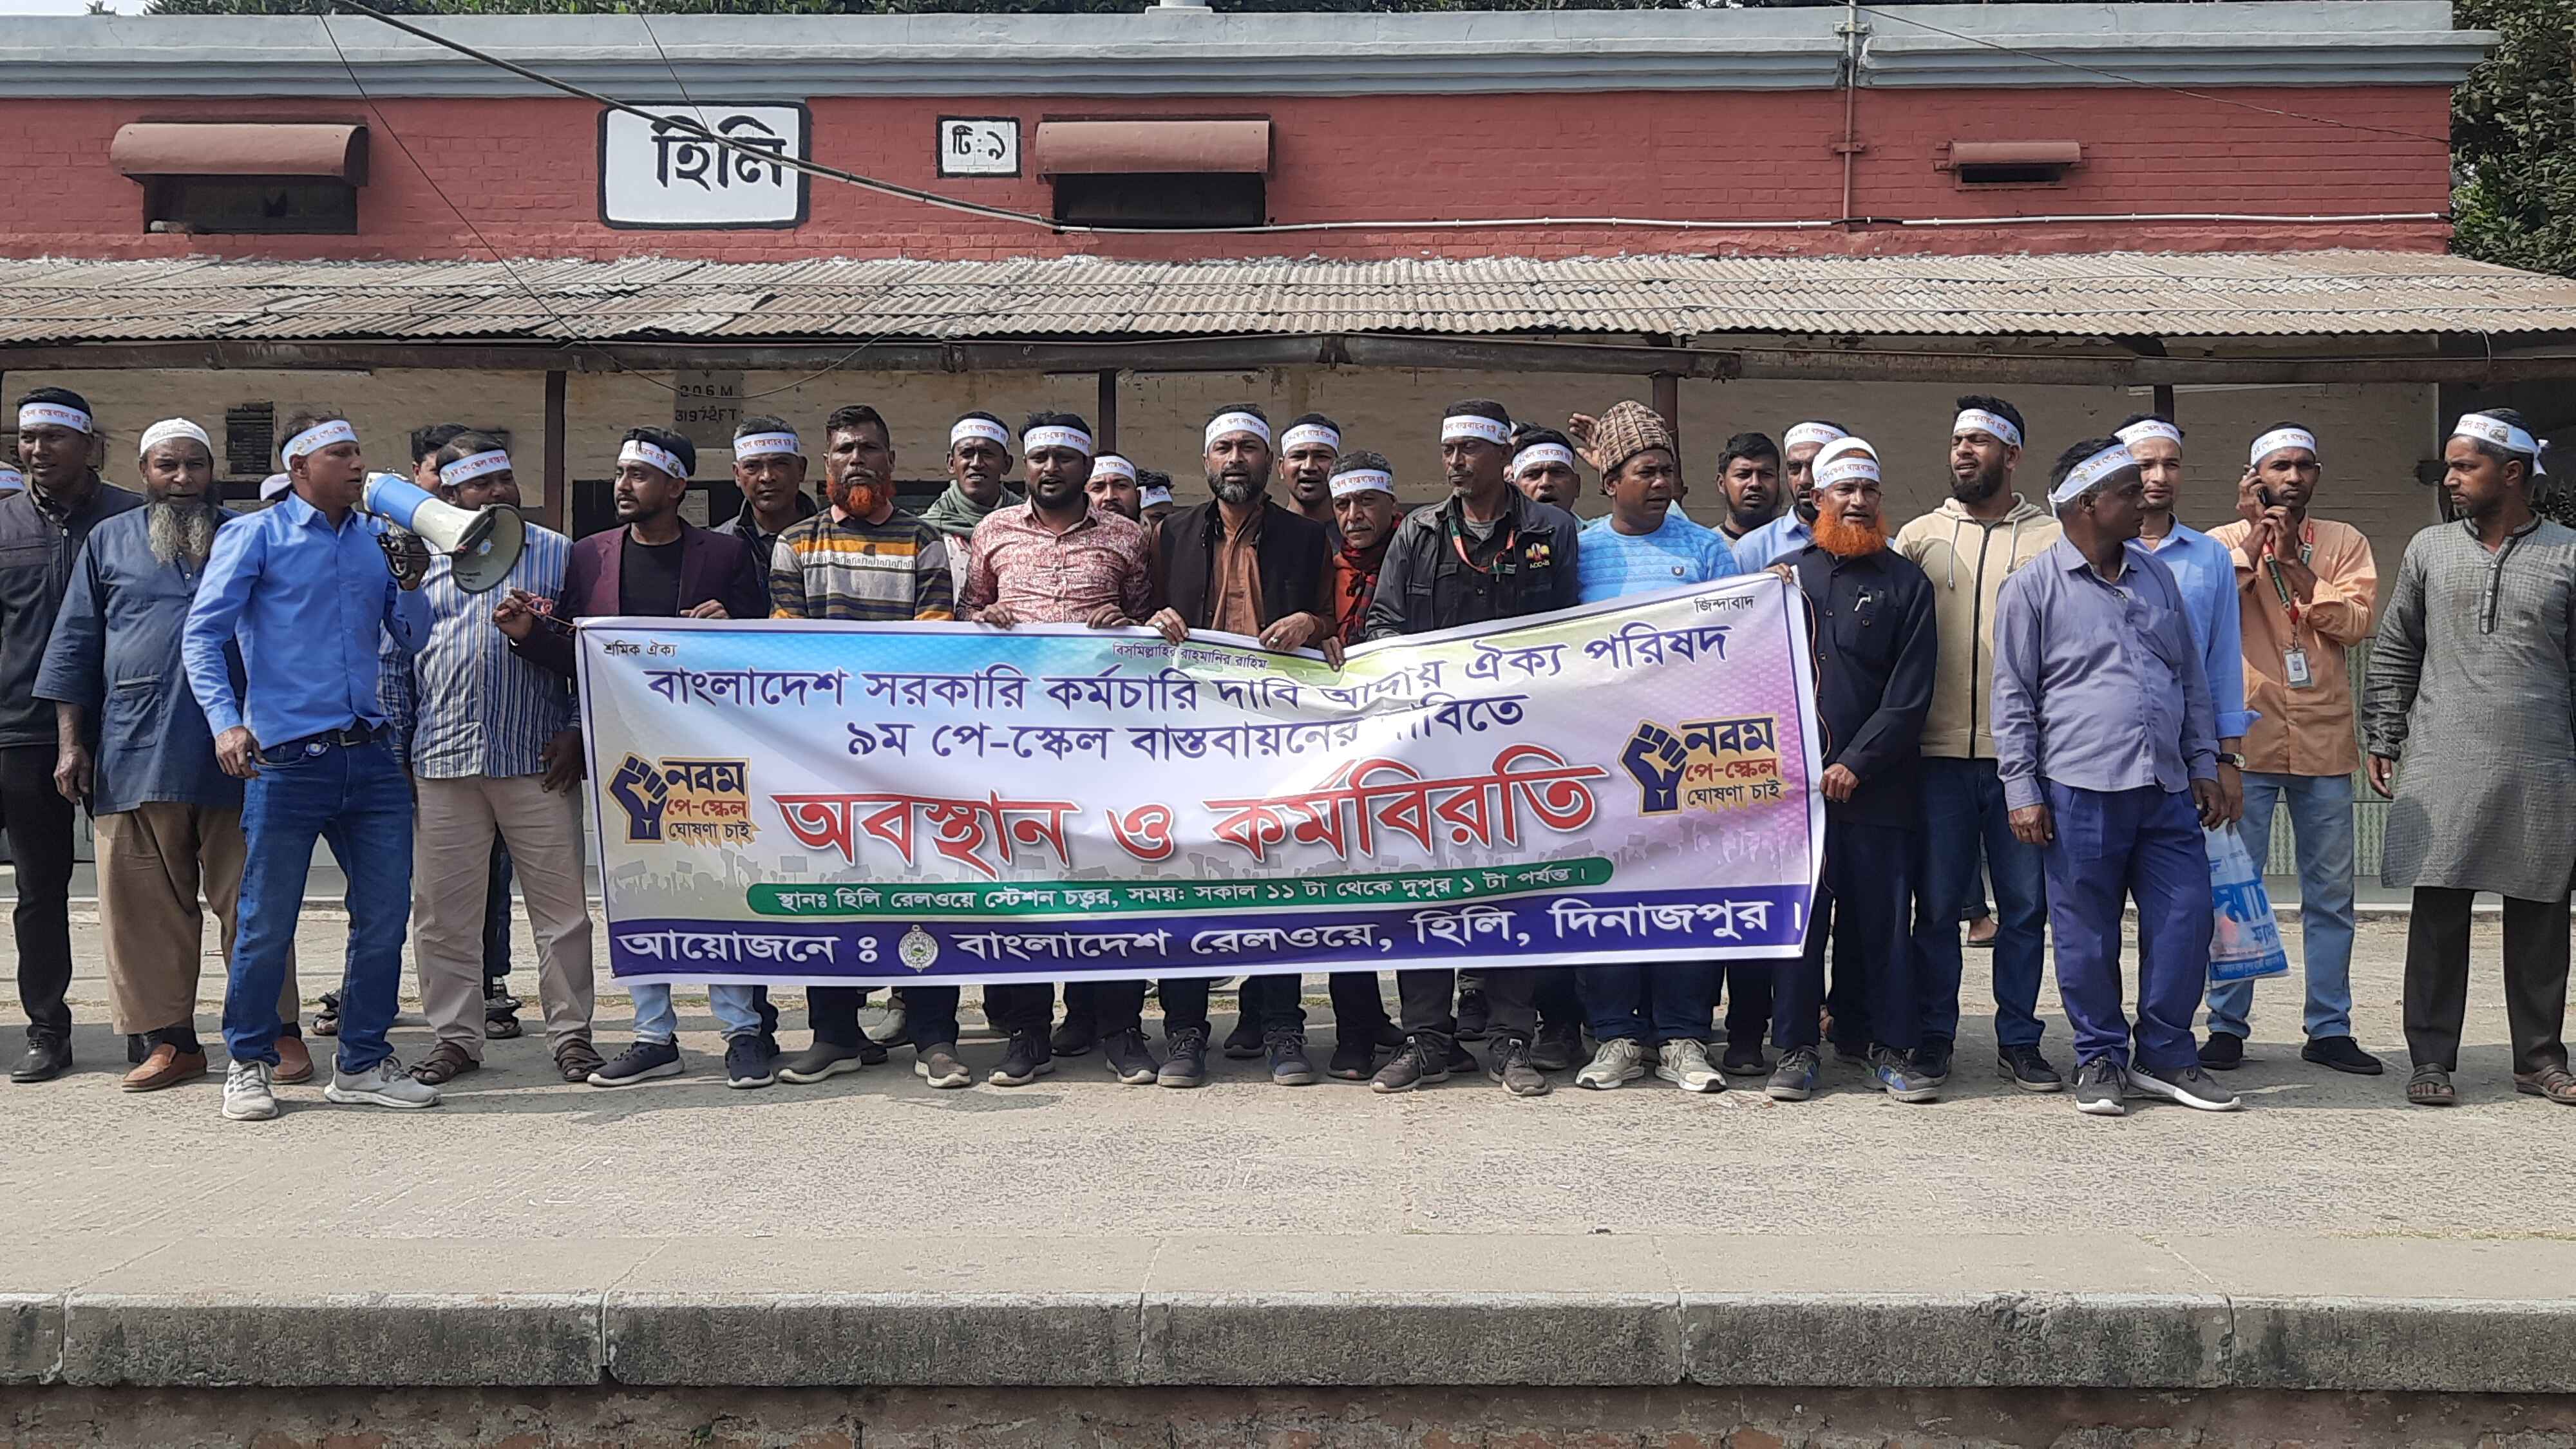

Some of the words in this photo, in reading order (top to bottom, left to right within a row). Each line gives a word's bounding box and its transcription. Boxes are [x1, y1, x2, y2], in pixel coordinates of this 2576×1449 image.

[651, 115, 786, 192] হিলি
[1694, 594, 1756, 614] জিন্দাবাদ
[603, 639, 641, 657] শ্রমিক
[647, 639, 677, 657] ঐক্য
[1235, 653, 1268, 670] রাহিম
[643, 667, 849, 708] বাংলাদেশ
[864, 661, 1030, 710] সরকারি
[1041, 661, 1202, 712] কর্মচারি
[1212, 672, 1306, 711] দাবি
[1320, 659, 1448, 708] আদায়
[1465, 641, 1568, 681] ঐক্য
[1584, 621, 1733, 669] পরিষদ
[846, 721, 916, 758] ৯ম
[932, 721, 1114, 762] পে-স্কেল
[1126, 716, 1360, 761] বাস্তবায়নের
[1681, 717, 1776, 758] নবম
[662, 761, 746, 795] নবম
[1685, 757, 1777, 782] পে-স্কেল
[1688, 784, 1745, 805] ঘোষণা
[1749, 778, 1782, 799] চাই
[667, 799, 747, 819] পে-স্কেল
[772, 790, 1080, 878] অবস্থান
[1105, 802, 1175, 862] ও
[1204, 745, 1606, 862] কর্মবিরতি
[669, 820, 719, 838] ঘোষণা
[723, 819, 752, 839] চাই
[835, 887, 882, 909] হিলি
[890, 891, 977, 909] রেলওয়ে
[985, 885, 1056, 910] স্টেশন
[1194, 882, 1258, 901] সকাল
[1266, 882, 1294, 900] ১১
[1301, 877, 1328, 900] টা
[1336, 879, 1394, 898] থেকে
[1397, 876, 1454, 900] দুপুর
[1461, 876, 1476, 894] ১
[1481, 869, 1507, 891] টা
[1516, 864, 1574, 886] পর্যন্ত
[616, 929, 841, 965] আয়োজনে
[951, 928, 1173, 964] বাংলাদেশ
[1191, 922, 1394, 954] রেলওয়ে,
[1411, 904, 1531, 948] হিলি,
[1547, 896, 1776, 939] দিনাজপুর
